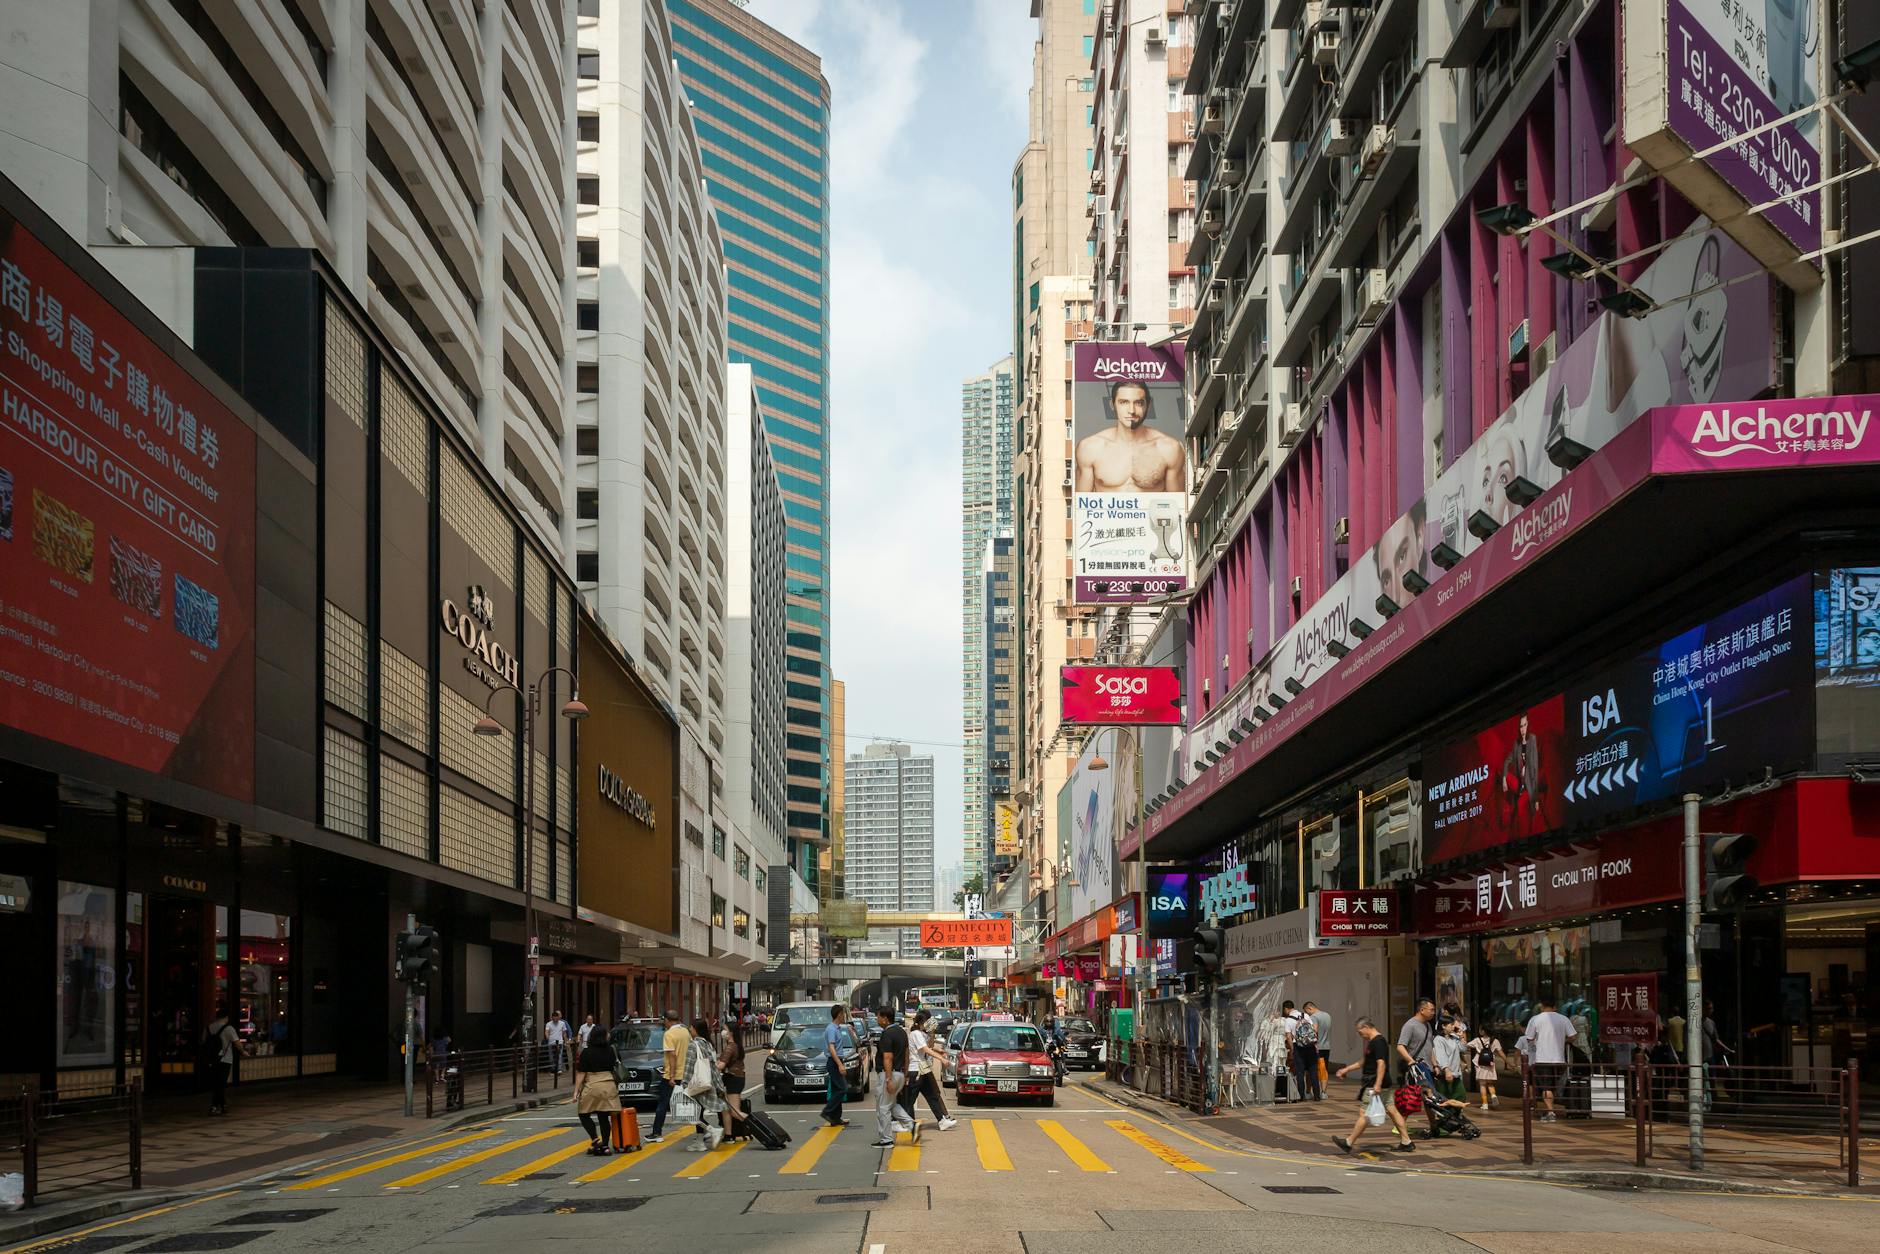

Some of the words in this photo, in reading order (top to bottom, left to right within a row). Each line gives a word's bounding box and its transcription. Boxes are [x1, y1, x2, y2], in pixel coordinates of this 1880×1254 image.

[1678, 24, 1714, 94] Tel:
[1720, 73, 1765, 147] 2302
[1093, 357, 1167, 379] Alchemy
[8, 330, 85, 410] Shopping
[90, 391, 119, 430] Mall
[123, 422, 169, 467] e-Cash
[172, 454, 219, 502] Voucher
[1691, 407, 1871, 450] Alchemy
[2, 390, 99, 475] HARBOUR
[102, 460, 139, 501] CITY
[142, 487, 176, 525] GIFT
[178, 511, 216, 552] CARD
[1078, 496, 1103, 509] Not
[1107, 496, 1139, 509] Just
[1086, 510, 1104, 519] For
[1107, 510, 1146, 519] Women
[1511, 487, 1574, 553] Alchemy
[1437, 586, 1454, 606] Since
[1457, 567, 1472, 593] 1994
[442, 599, 519, 690] COACH
[1295, 596, 1350, 672] Alchemy
[1652, 607, 1792, 688] 中港城奧特萊斯旗艦店
[466, 658, 482, 679] NEW
[482, 670, 500, 690] YORK
[1095, 674, 1148, 694] Sasa
[1652, 688, 1671, 706] China
[1671, 679, 1688, 699] Hong
[1688, 669, 1705, 692] Kong
[1705, 663, 1720, 684] City
[1720, 653, 1741, 677] Outlet
[1741, 639, 1772, 670] Flagship
[1772, 630, 1792, 657] Store
[1111, 696, 1131, 706] 莎莎
[1582, 688, 1621, 737] ISA
[1576, 740, 1629, 775] 步行約五分鐘
[1428, 782, 1447, 802] NEW
[1448, 764, 1489, 794] ARRIVALS
[1446, 810, 1468, 825] WINTER
[1469, 805, 1483, 818] 2019
[163, 875, 207, 893] COACH
[1552, 873, 1579, 888] CHOW
[1581, 866, 1598, 881] TAI
[1601, 858, 1632, 877] FOOK
[1151, 896, 1186, 911] ISA
[1331, 897, 1389, 914] 周大福
[1476, 864, 1538, 916] 周大福
[946, 922, 1007, 932] TIMECITY
[1258, 934, 1273, 951] BANK
[1274, 931, 1282, 947] OF
[1283, 927, 1304, 946] CHINA
[1606, 986, 1648, 1011] 周大福
